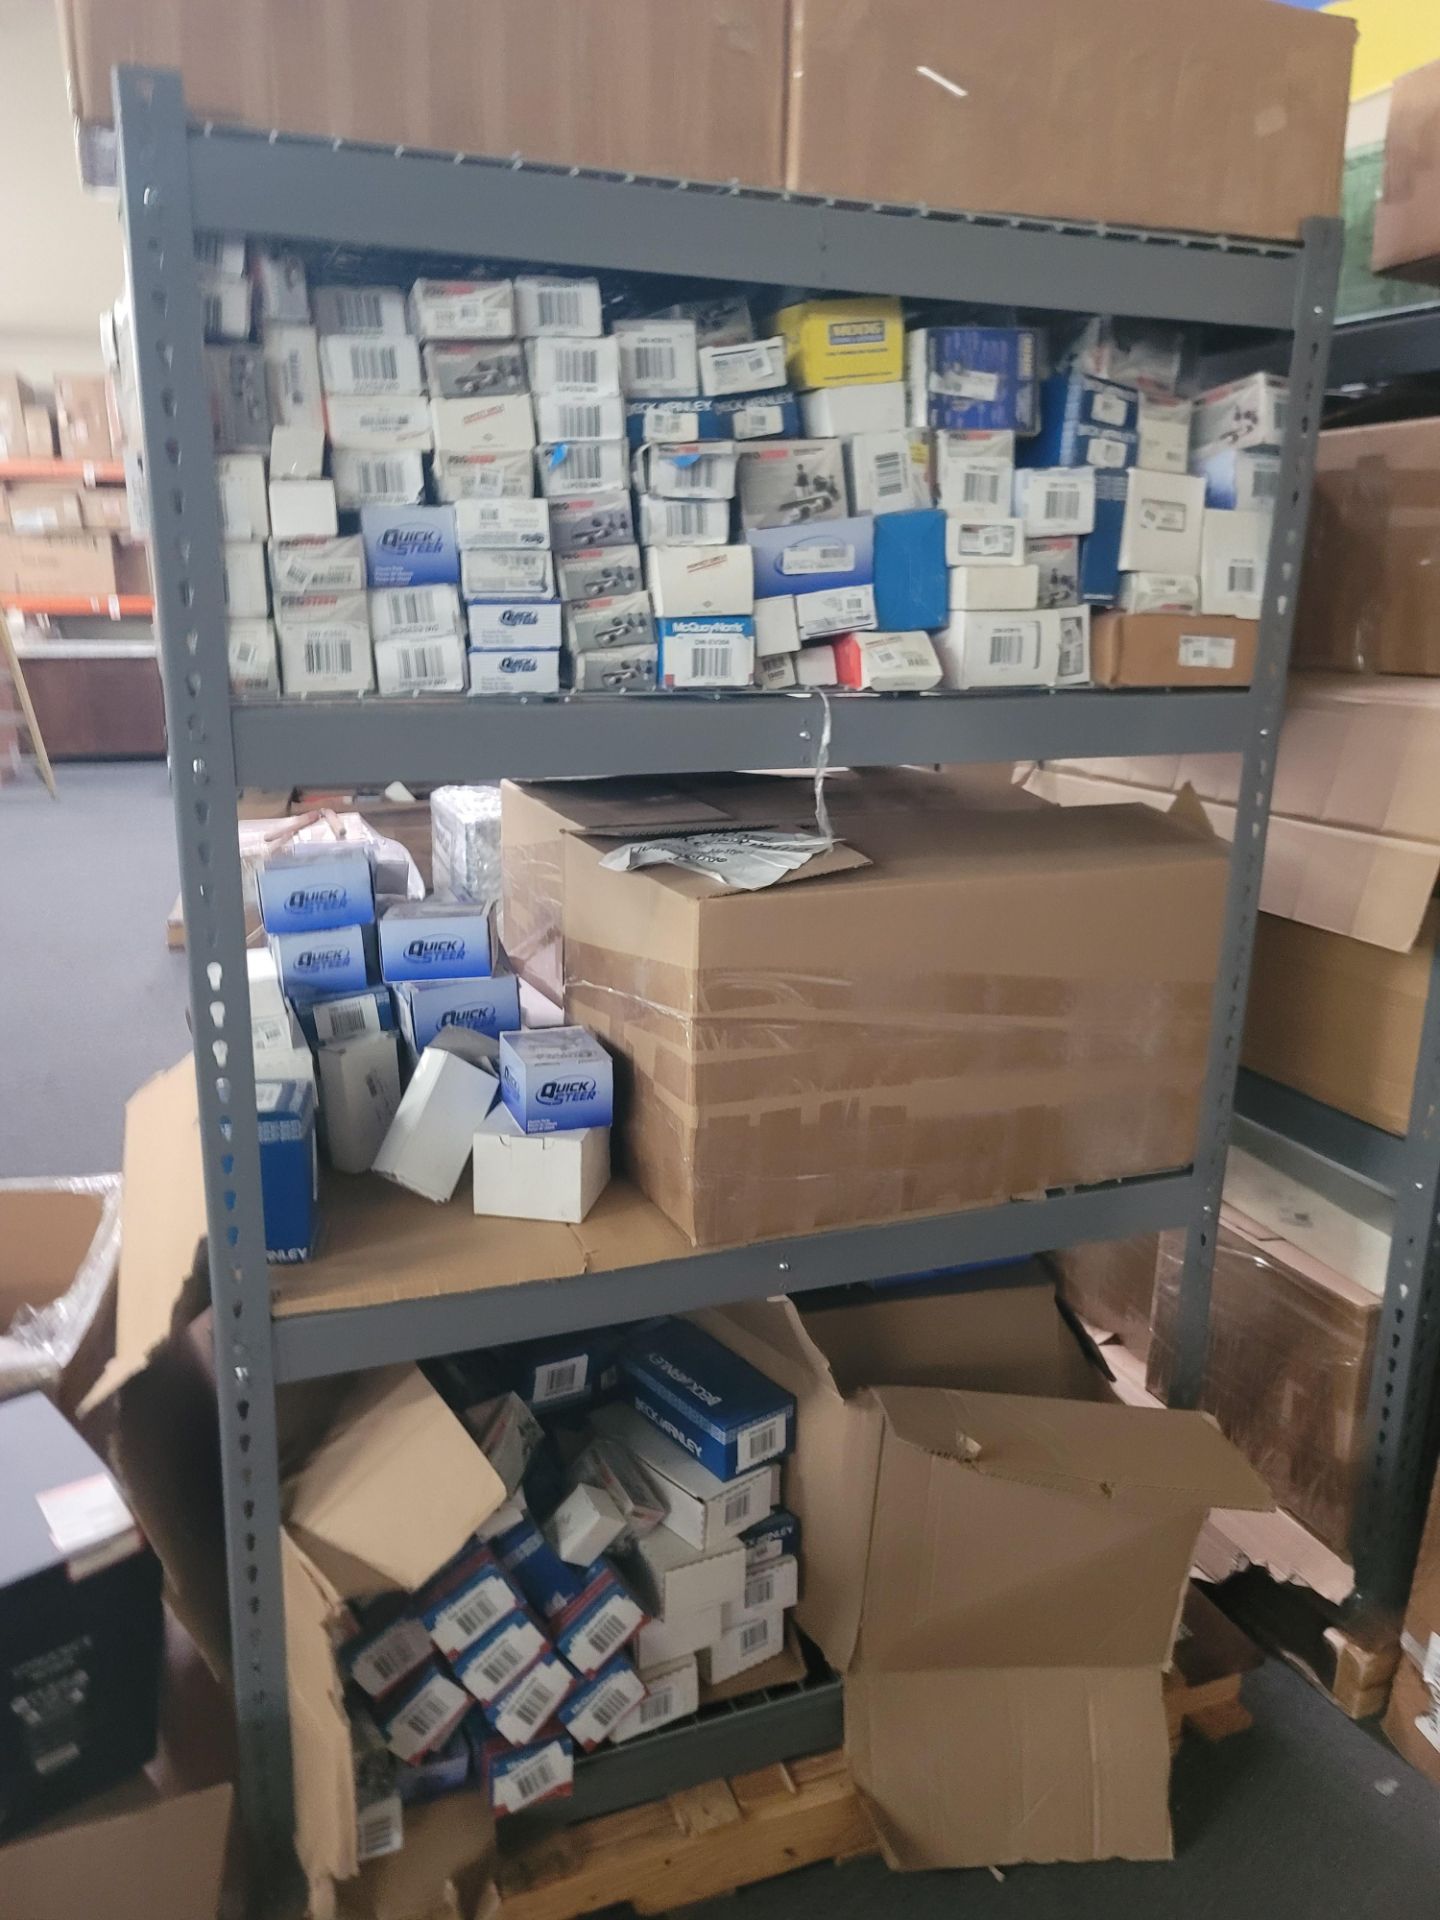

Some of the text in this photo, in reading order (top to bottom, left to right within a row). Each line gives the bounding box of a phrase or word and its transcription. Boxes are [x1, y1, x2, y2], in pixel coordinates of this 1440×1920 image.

[381, 528, 434, 547] QUICK
[289, 889, 339, 908] QUICK
[409, 939, 457, 957] QUICK
[422, 949, 466, 963] STEER
[298, 950, 343, 967] QUICK
[441, 1007, 488, 1027] QUICK
[540, 1081, 590, 1098] QUICK
[554, 1090, 597, 1105] STEER
